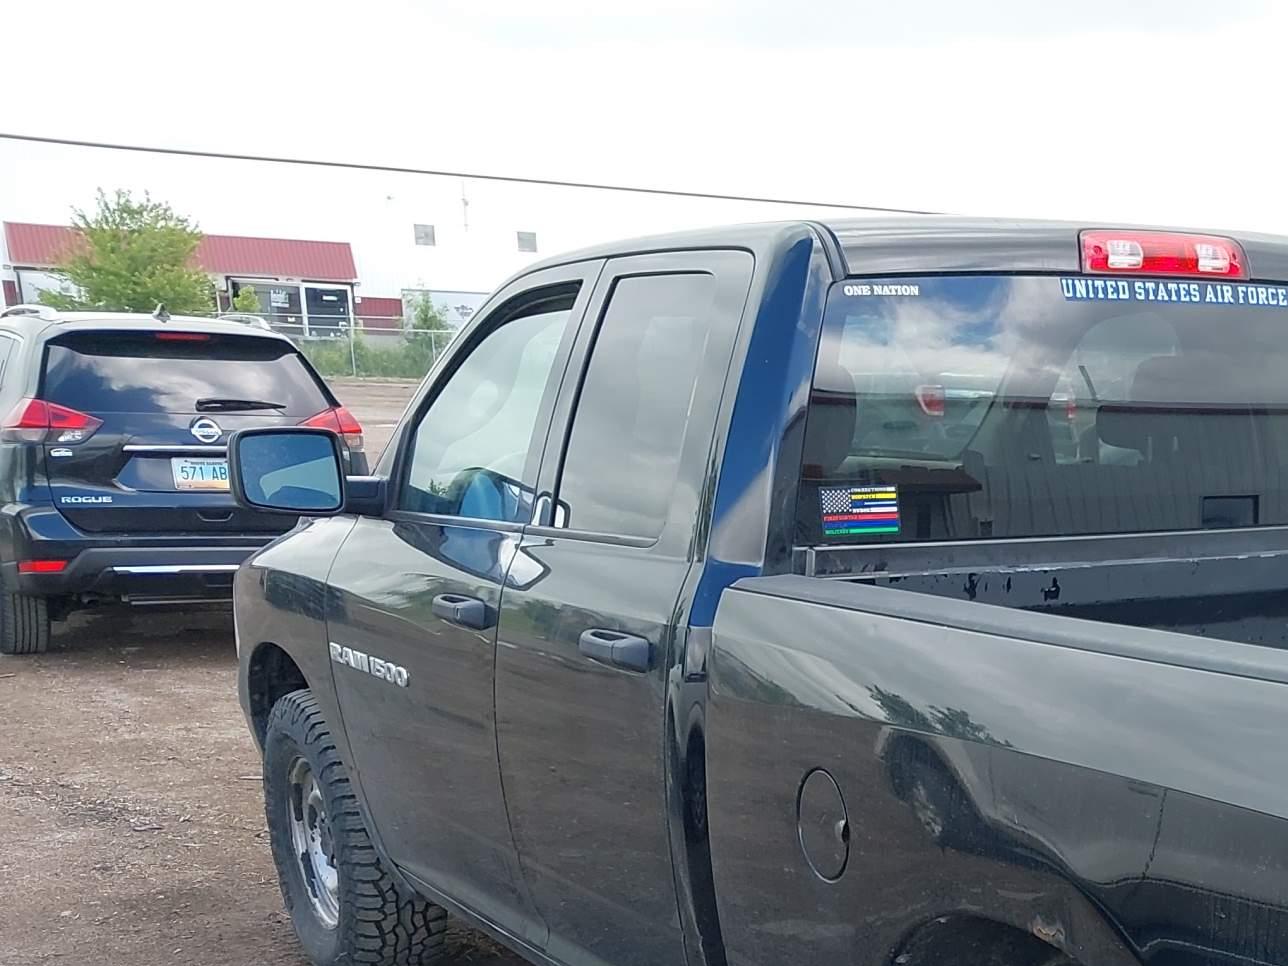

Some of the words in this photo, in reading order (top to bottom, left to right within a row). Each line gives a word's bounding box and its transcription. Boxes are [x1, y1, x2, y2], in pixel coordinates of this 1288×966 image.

[843, 285, 871, 296] ONE
[872, 285, 919, 296] NATION
[1061, 278, 1130, 299] UNITED
[1135, 282, 1200, 302] STATES
[1205, 285, 1234, 304] AIR
[1238, 286, 1288, 307] FORCE
[180, 466, 205, 481] 571
[329, 641, 370, 673] RAM
[369, 655, 409, 688] 1500
